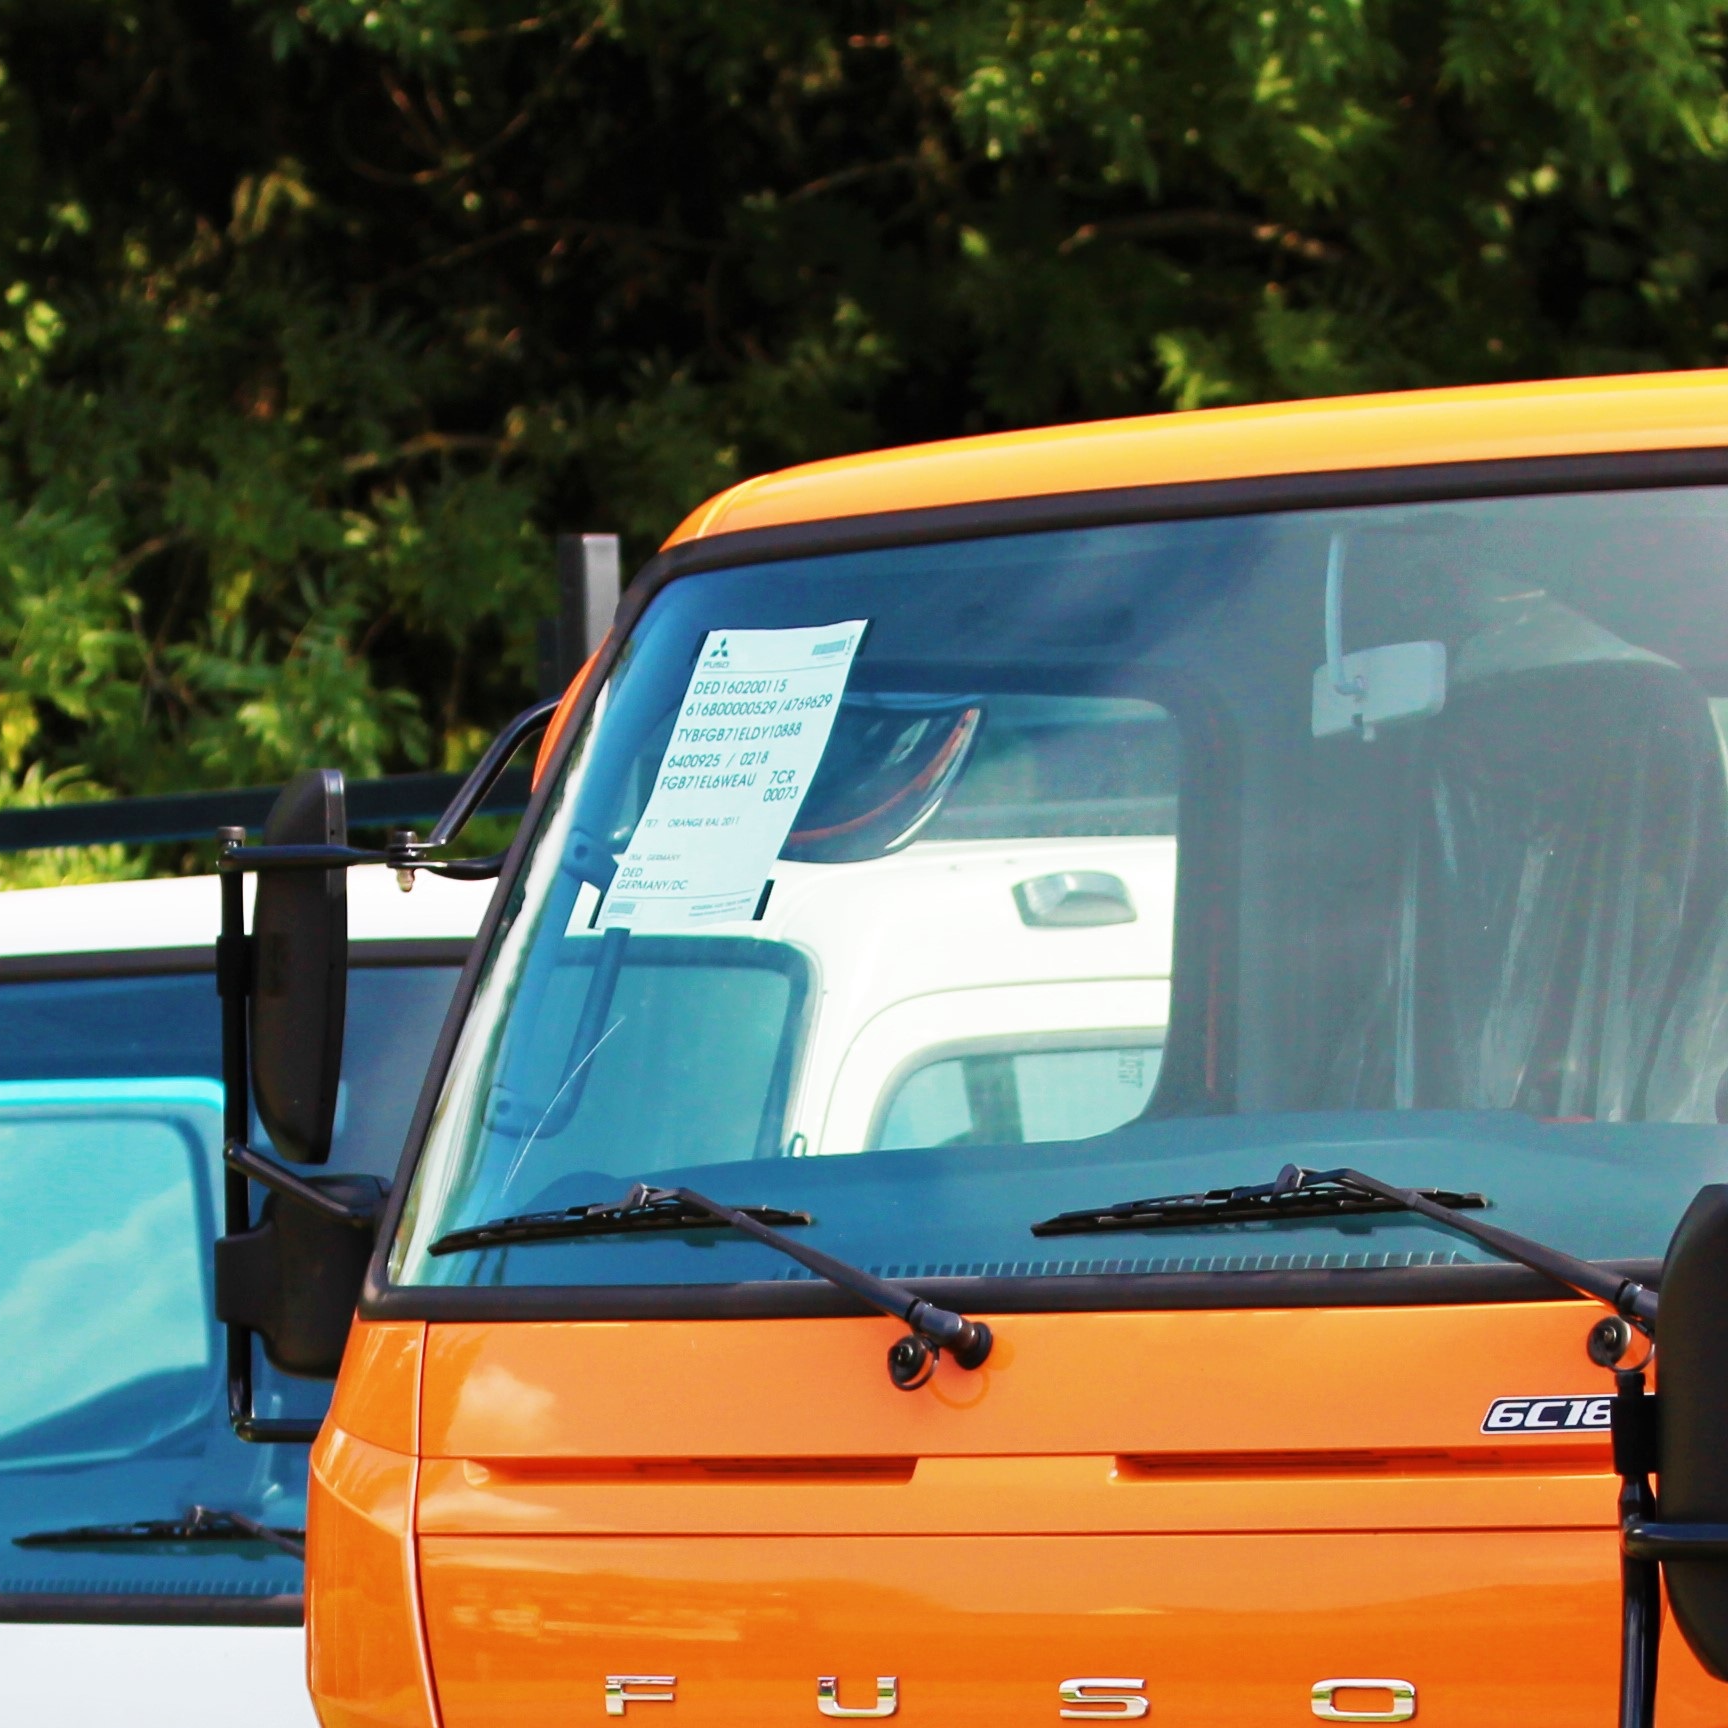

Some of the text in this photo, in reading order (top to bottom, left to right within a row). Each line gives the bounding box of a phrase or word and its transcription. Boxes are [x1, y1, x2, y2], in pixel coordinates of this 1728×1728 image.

[693, 679, 789, 695] DED160200115
[667, 753, 721, 769] 6400925
[739, 750, 770, 766] 0218
[769, 770, 796, 785] 7CR
[762, 786, 799, 802] 00073
[667, 818, 703, 829] ORANGE
[622, 867, 643, 878] DED
[616, 879, 688, 891] GERMANY/DC
[605, 1675, 1416, 1723] FUSO
